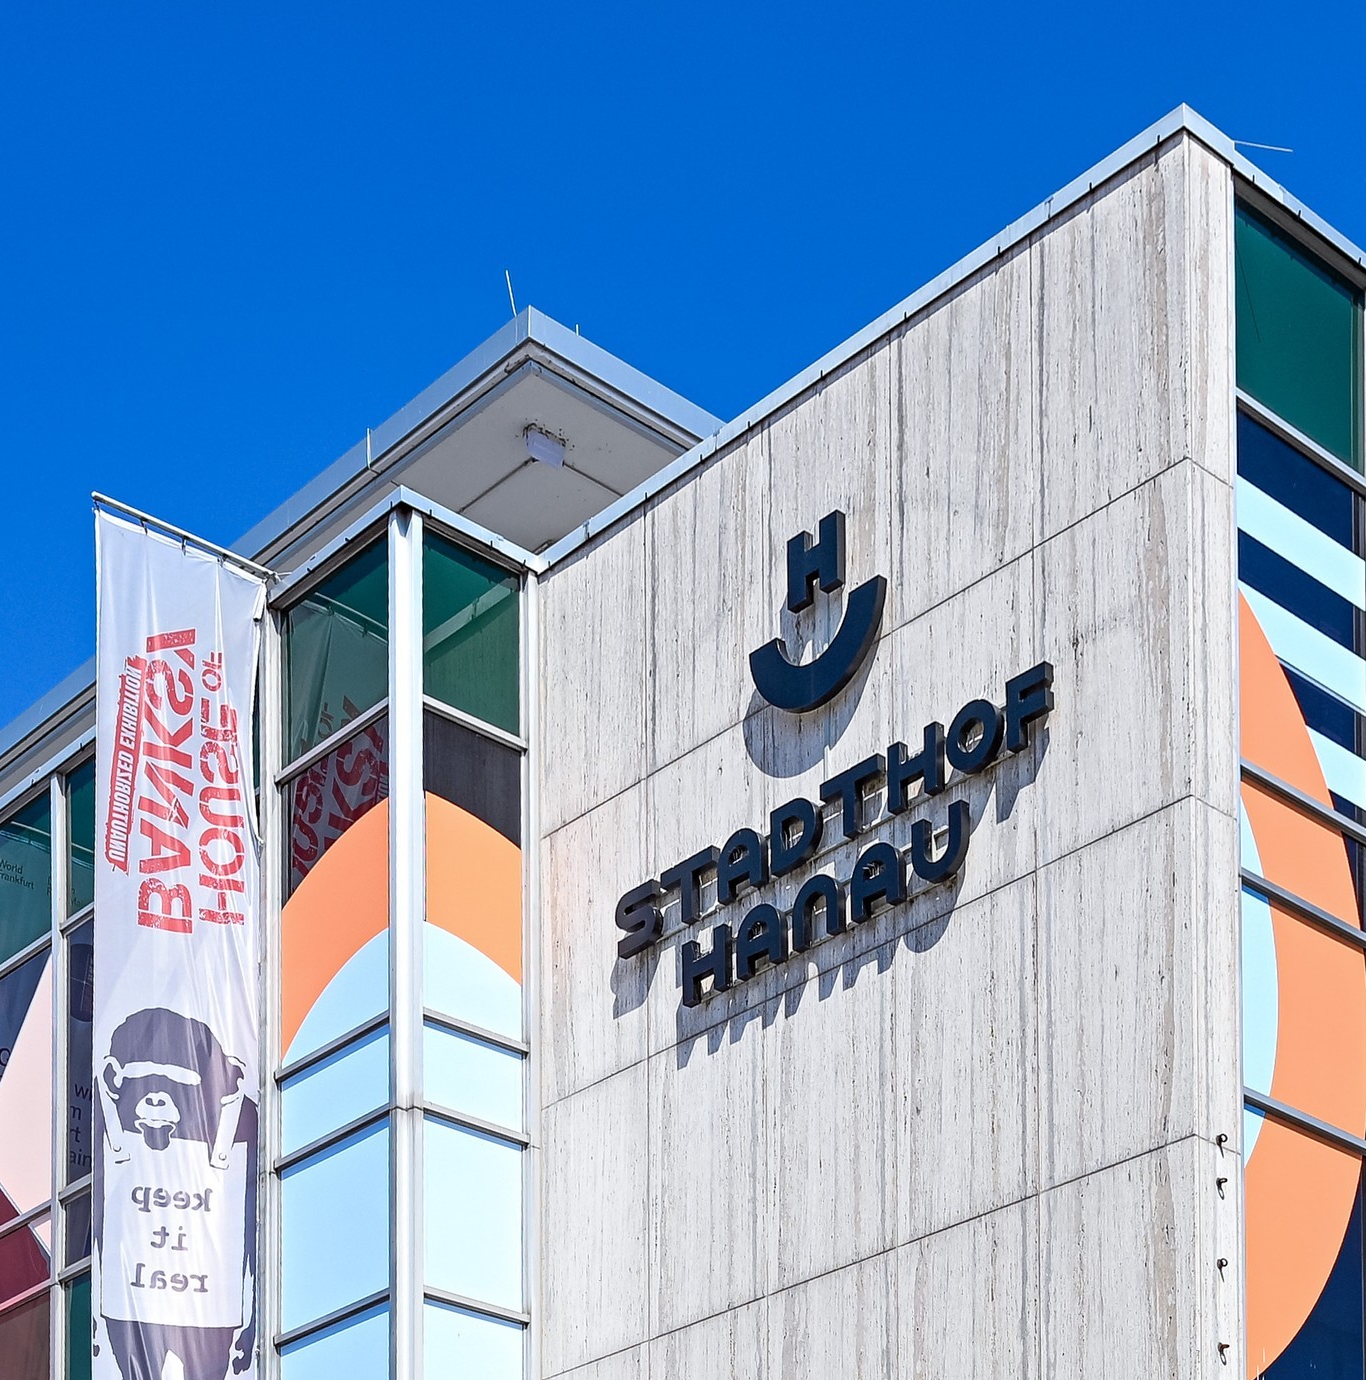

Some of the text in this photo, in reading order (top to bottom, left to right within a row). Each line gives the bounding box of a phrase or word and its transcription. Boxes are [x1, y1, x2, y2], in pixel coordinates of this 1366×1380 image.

[787, 509, 846, 614] H
[614, 660, 1055, 959] STADTHOF
[681, 800, 970, 1008] HANAU
